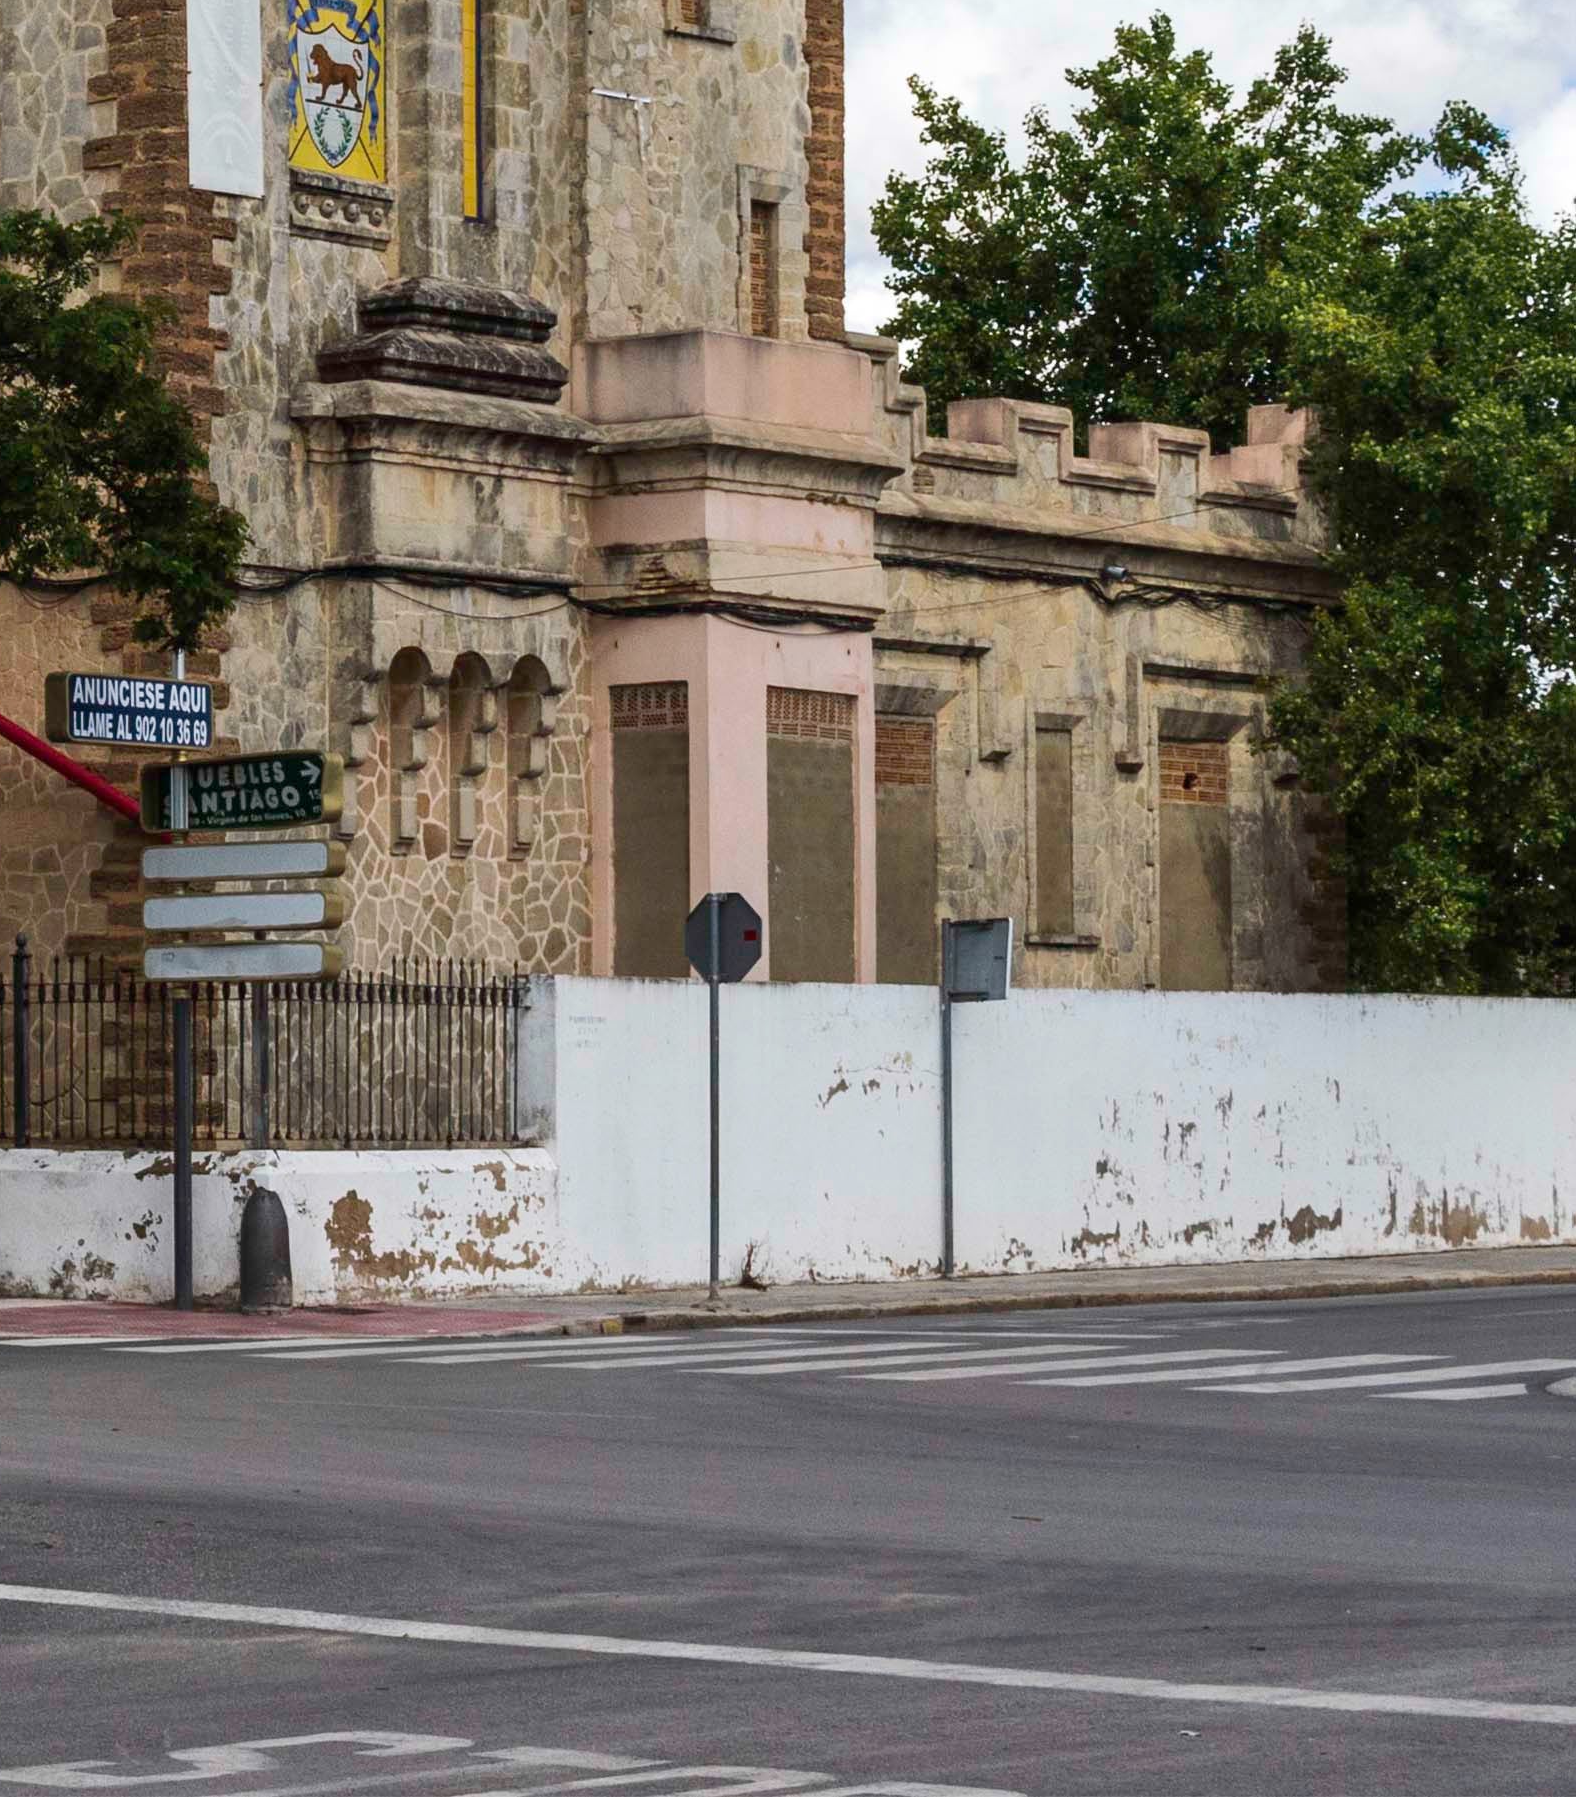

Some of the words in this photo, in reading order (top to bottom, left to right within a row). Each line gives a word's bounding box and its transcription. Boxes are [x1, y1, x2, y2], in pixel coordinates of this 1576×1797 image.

[73, 676, 165, 711] ANUNCIESE
[169, 684, 207, 714] AQUI
[73, 711, 113, 739] LLAME
[116, 714, 133, 740] AL
[135, 715, 157, 742] 902
[160, 717, 174, 744] 10
[177, 718, 191, 745] 36
[193, 720, 208, 746] 69
[188, 760, 286, 789] UEBLES
